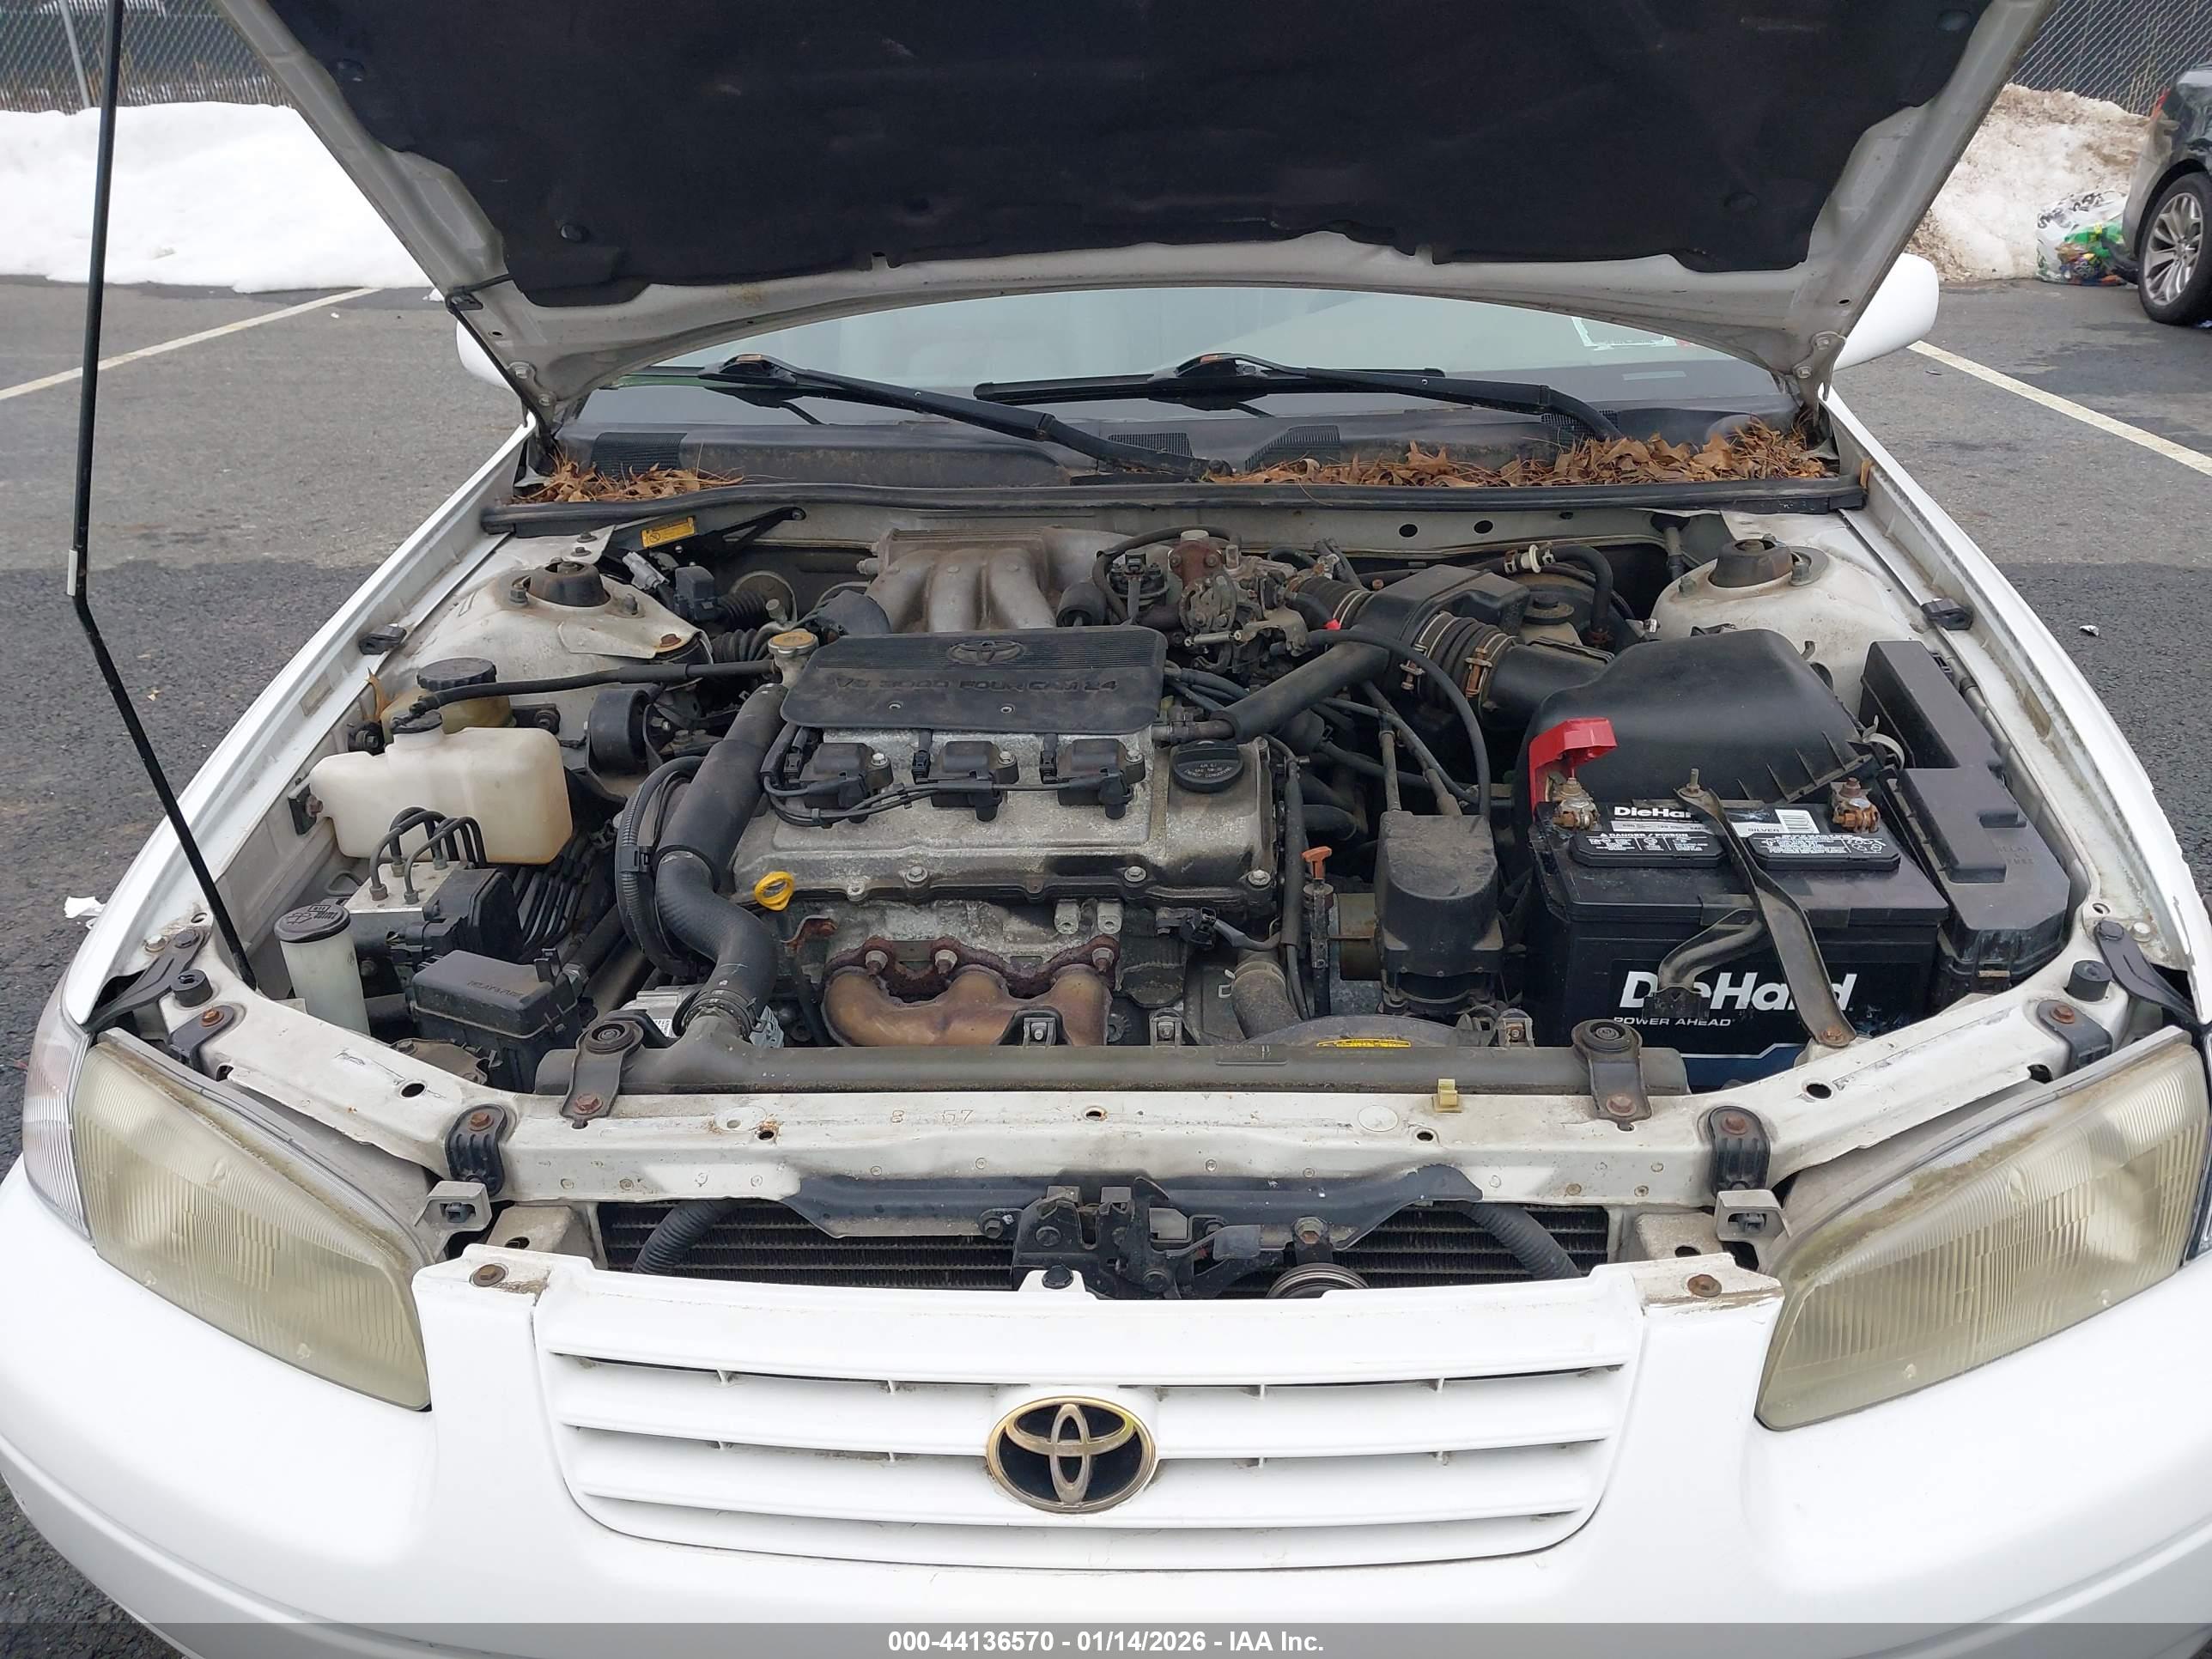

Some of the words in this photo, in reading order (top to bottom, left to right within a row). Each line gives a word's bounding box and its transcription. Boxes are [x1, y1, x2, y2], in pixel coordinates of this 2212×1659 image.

[958, 678, 1024, 691] FOUR
[1613, 806, 1692, 818] DieHar
[1613, 1017, 1670, 1026] POWER
[1674, 1018, 1731, 1027] AHEAD
